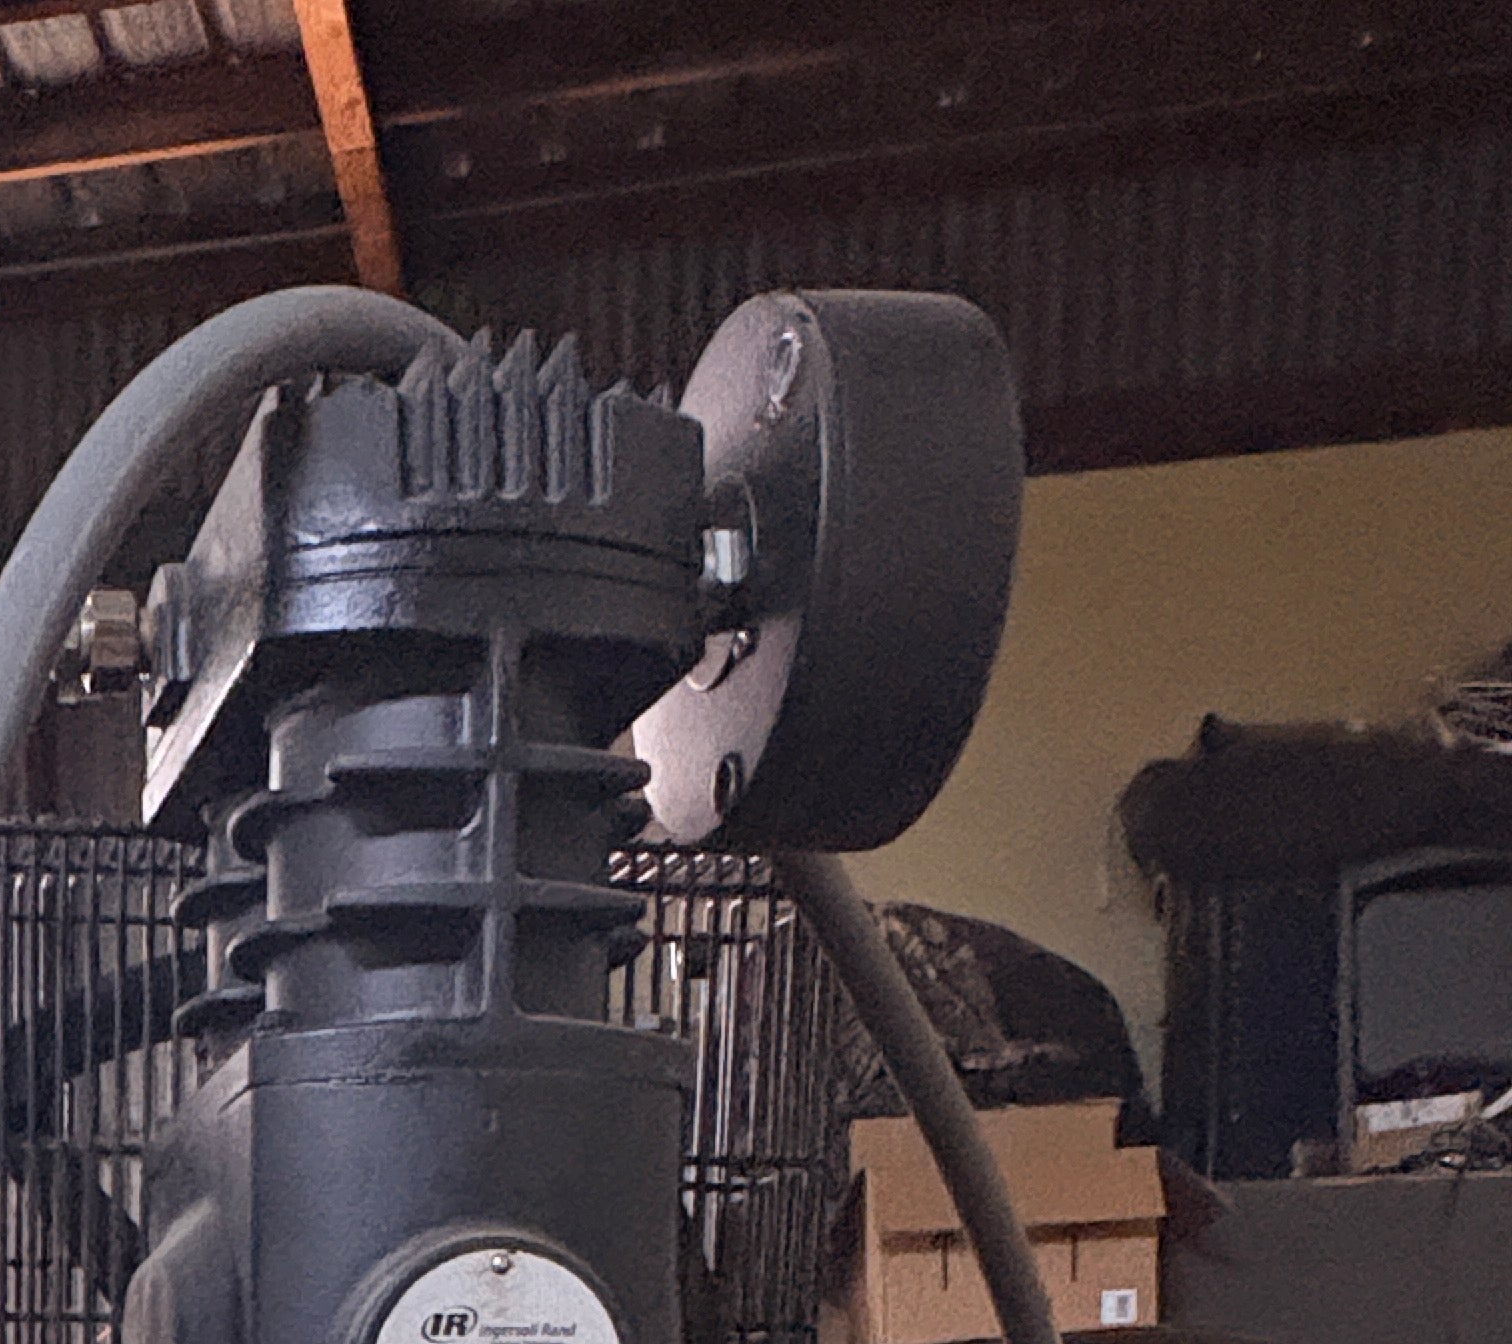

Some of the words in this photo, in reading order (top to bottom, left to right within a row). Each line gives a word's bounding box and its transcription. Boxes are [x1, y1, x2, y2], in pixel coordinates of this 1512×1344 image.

[431, 1312, 469, 1337] IR
[479, 1324, 537, 1338] Ingersoll
[541, 1322, 576, 1337] Rand
